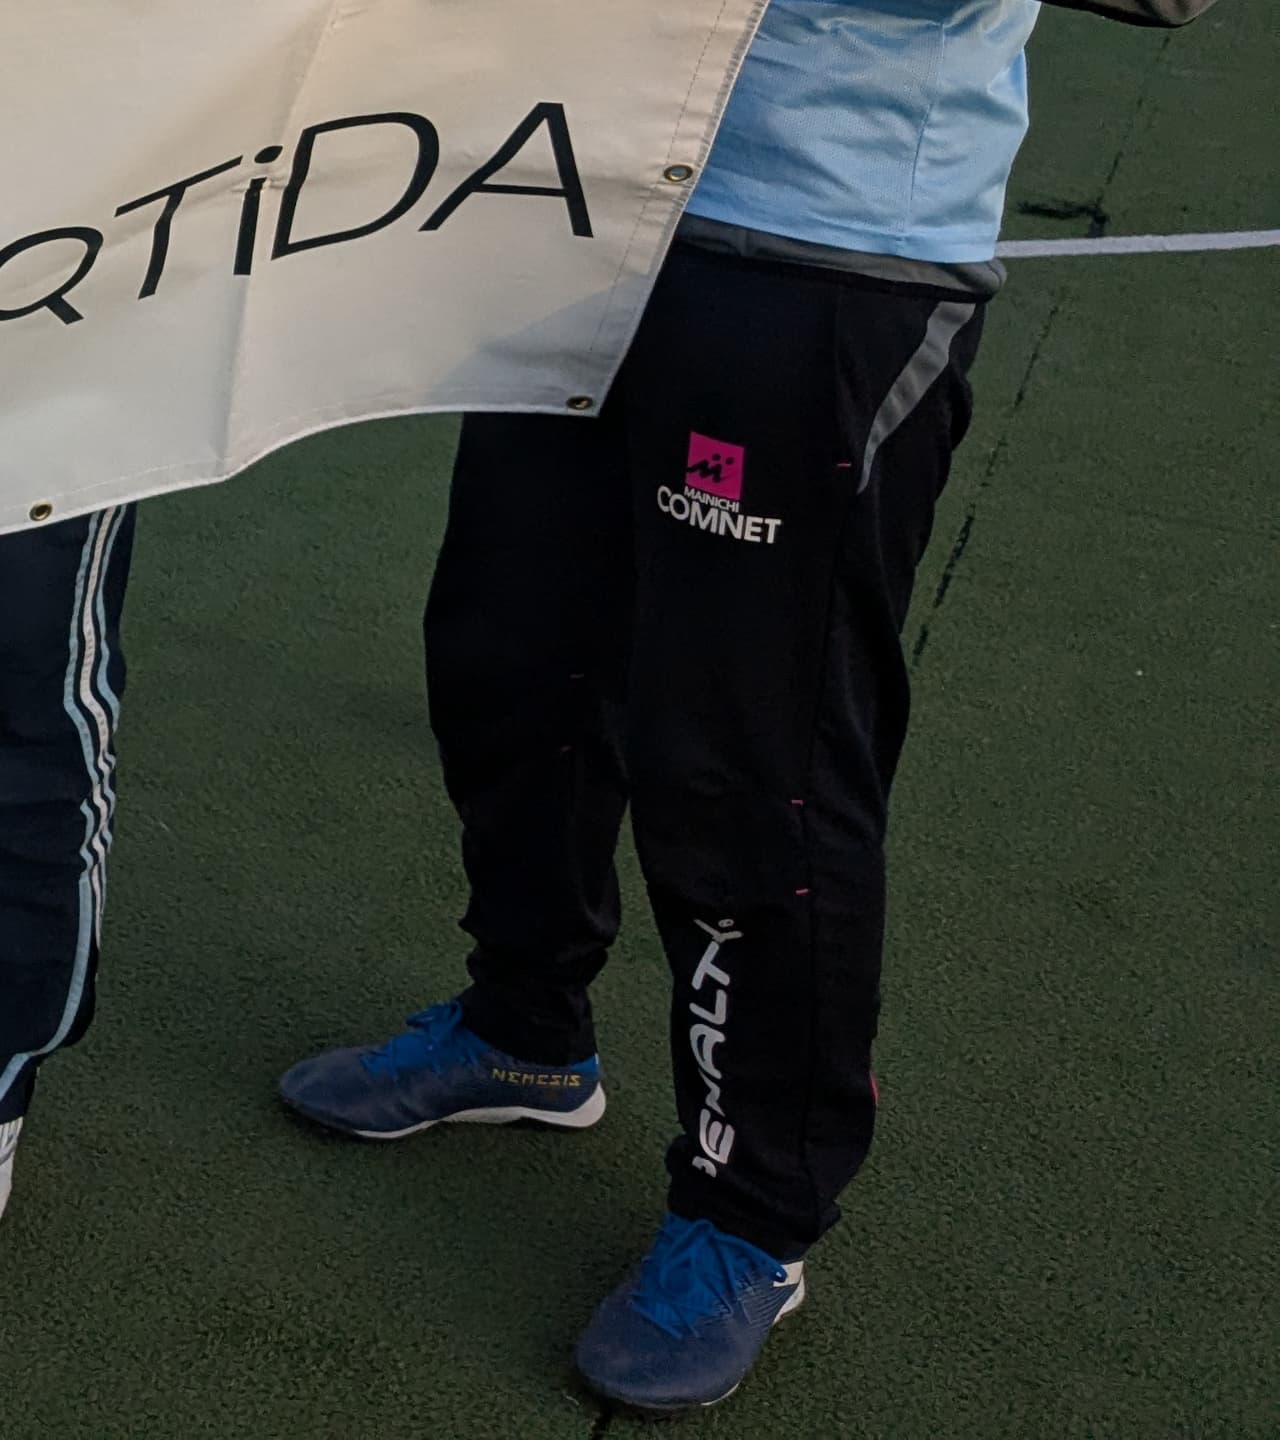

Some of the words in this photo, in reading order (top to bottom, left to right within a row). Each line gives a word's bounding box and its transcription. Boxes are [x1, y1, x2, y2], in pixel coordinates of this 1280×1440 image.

[684, 486, 740, 513] MAINICHI
[657, 485, 782, 544] COMNET
[492, 1067, 582, 1087] NEMESIS
